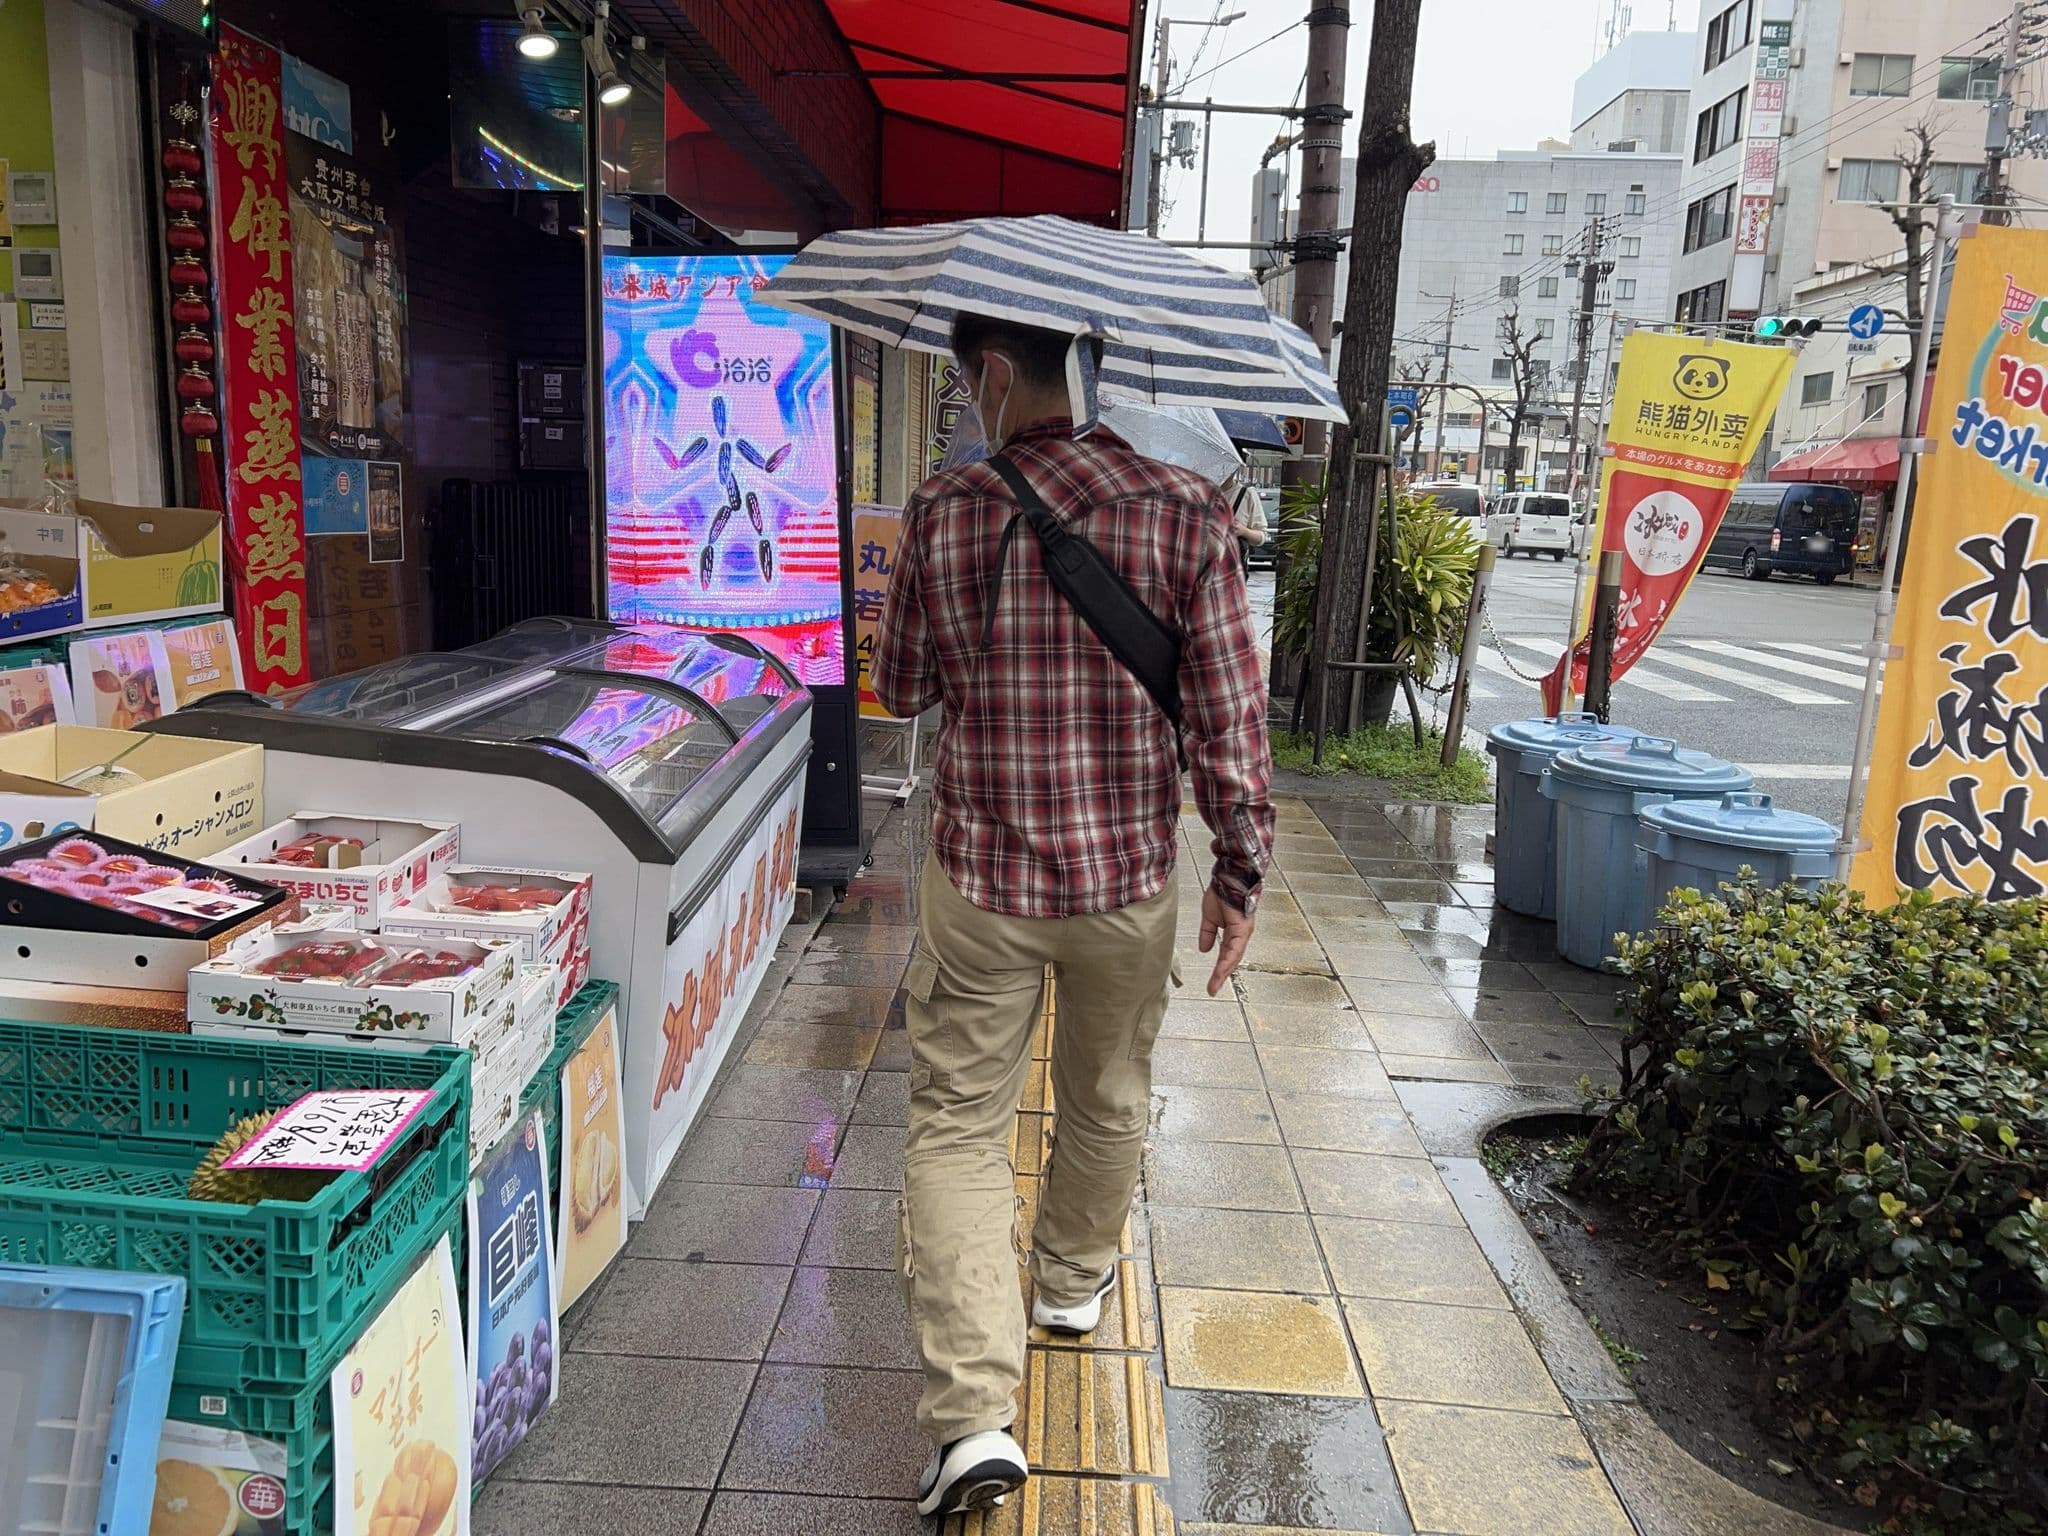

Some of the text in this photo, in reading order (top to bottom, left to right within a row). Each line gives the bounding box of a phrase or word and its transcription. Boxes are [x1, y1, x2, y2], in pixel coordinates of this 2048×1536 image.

[723, 357, 771, 383] 洽洽
[1634, 426, 1741, 450] HUNGRYPANDA
[1637, 400, 1749, 441] 熊猫外卖
[139, 798, 254, 850] がみオーシャンメロン
[489, 1190, 540, 1309] 巨峰
